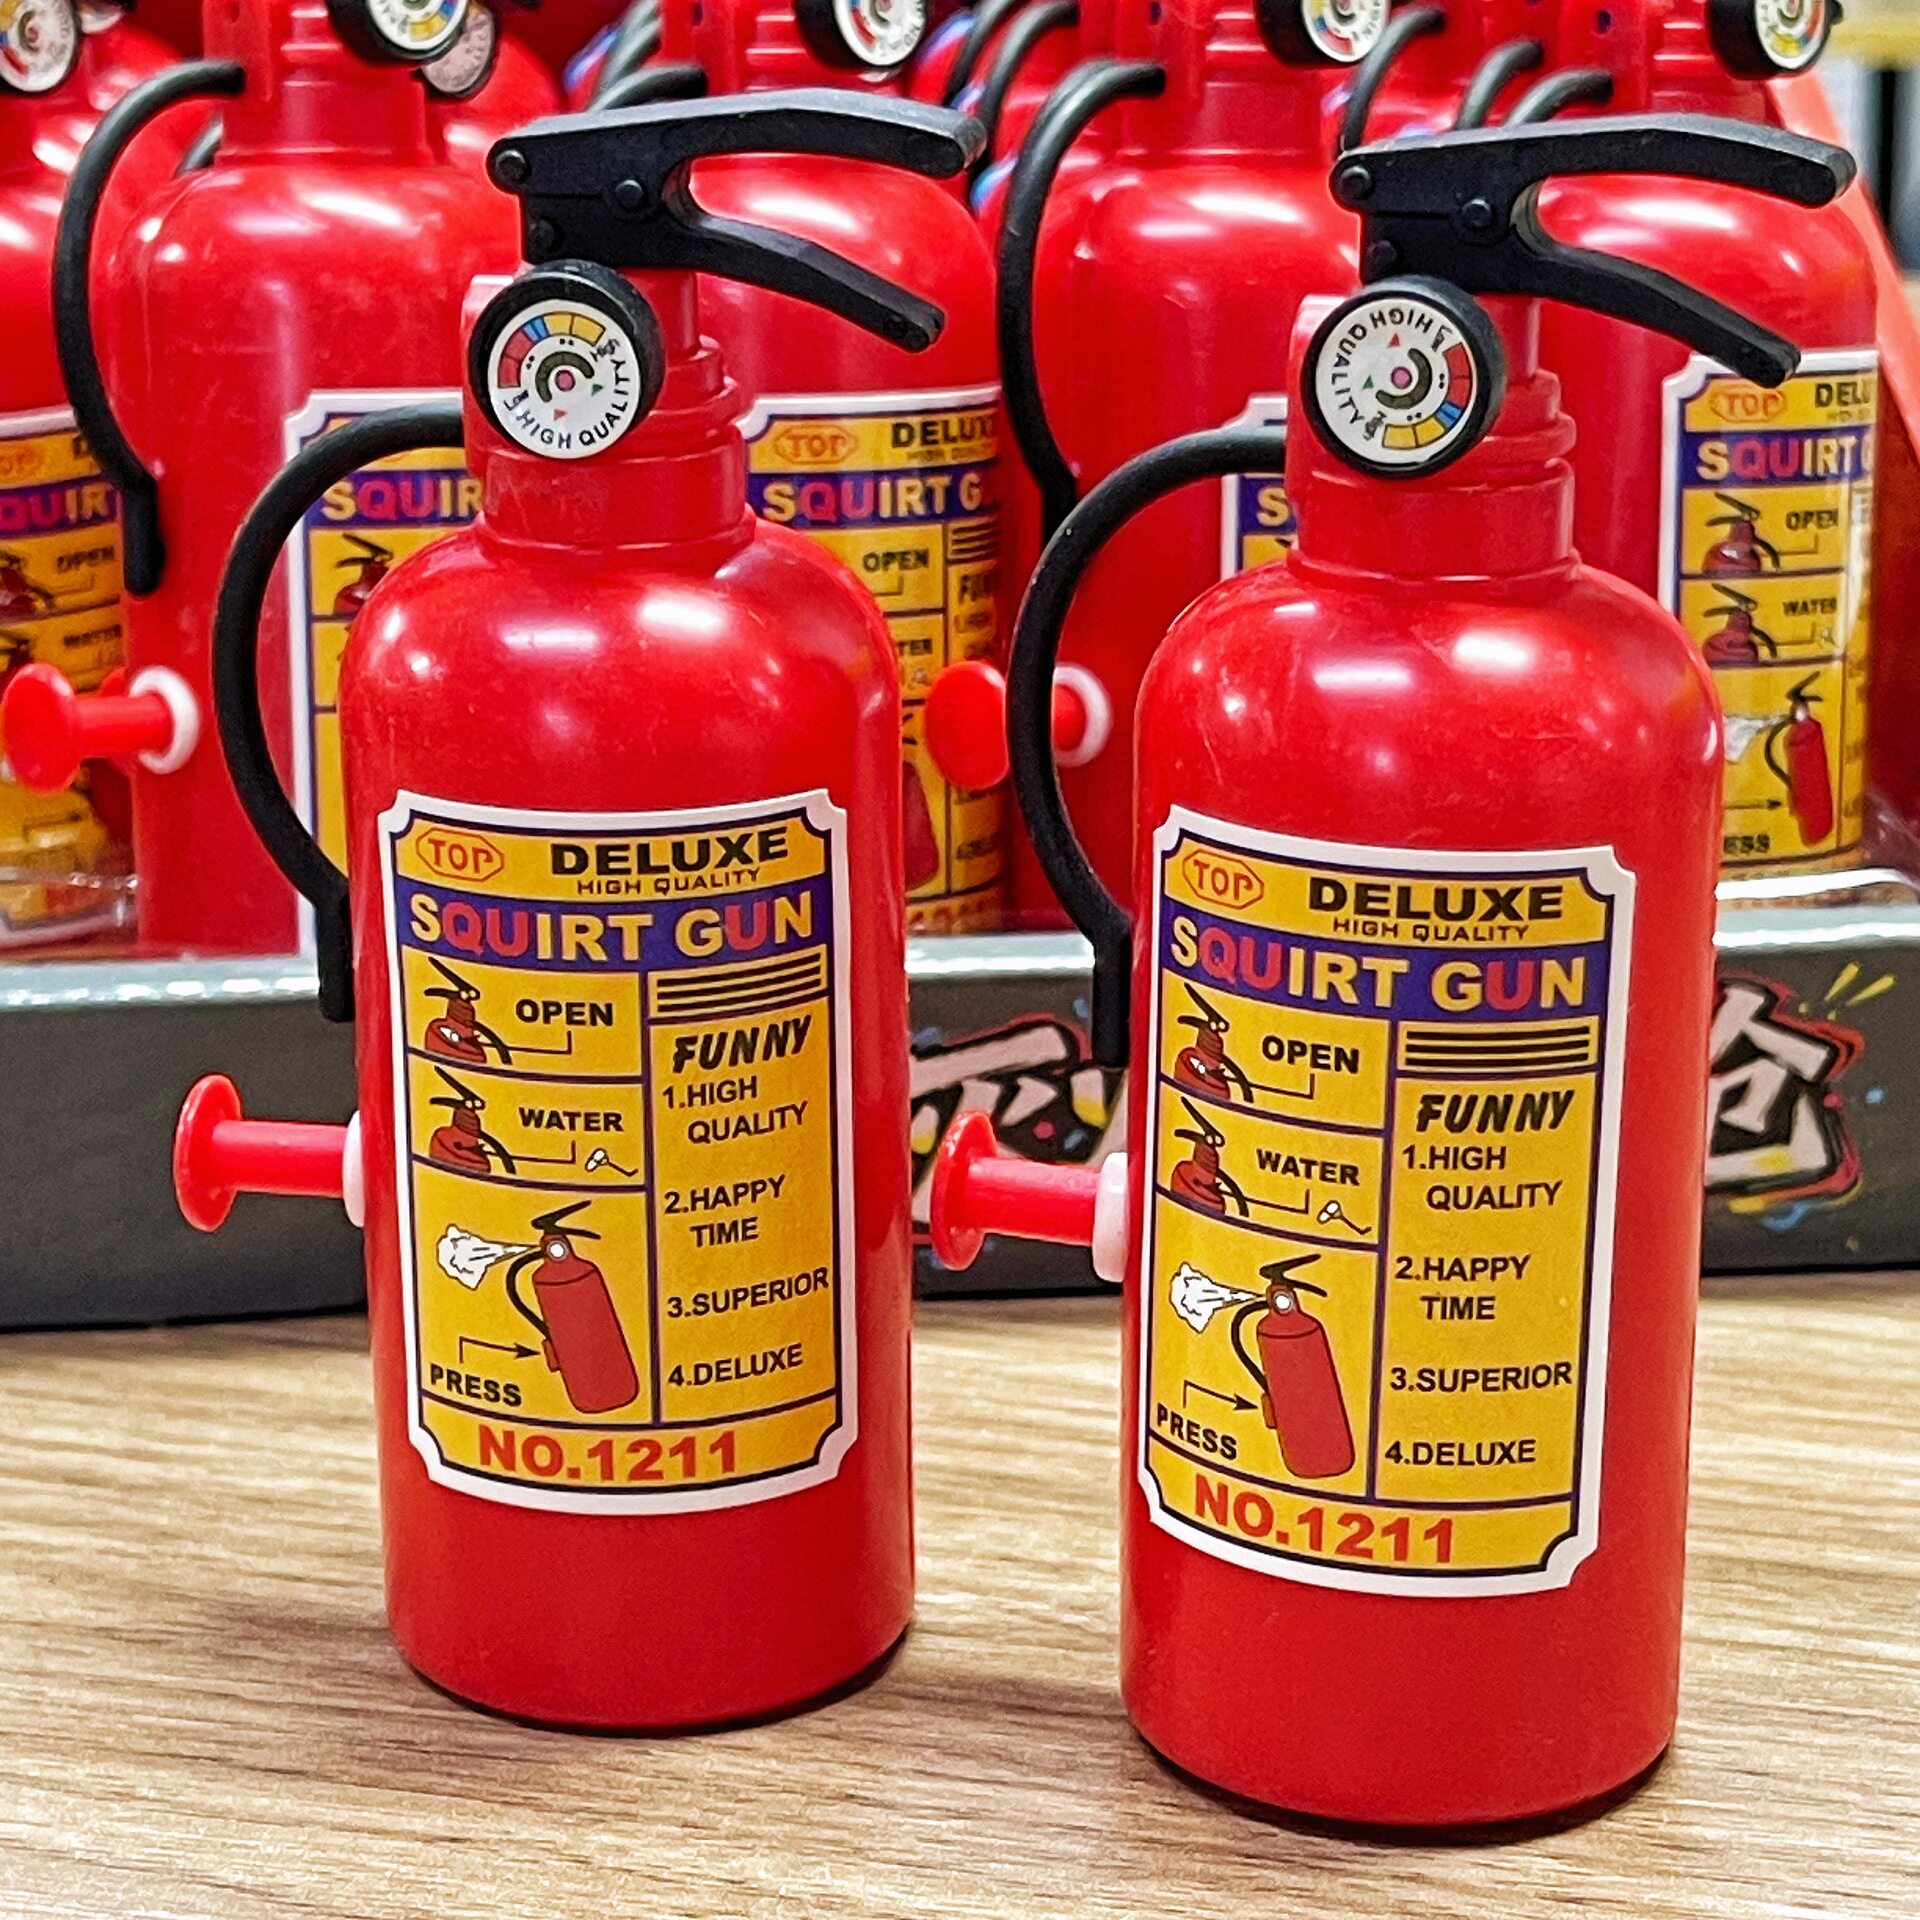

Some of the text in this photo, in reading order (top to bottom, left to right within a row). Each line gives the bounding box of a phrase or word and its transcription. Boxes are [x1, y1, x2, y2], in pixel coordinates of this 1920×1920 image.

[1370, 308, 1434, 333] HIGH
[1332, 322, 1367, 424] QUALITY
[516, 358, 631, 449] HIGH QUALITY
[1726, 393, 1780, 418] TOP
[1696, 434, 1858, 481] SQUIRT
[0, 483, 110, 530] QUIR
[320, 475, 484, 522] SQUIR
[762, 474, 953, 524] SQUIRT
[862, 548, 930, 573] OPEN
[897, 638, 933, 657] TER
[427, 837, 494, 876] TOP
[550, 825, 789, 876] DELUXE
[1723, 833, 1771, 854] ESS
[577, 867, 762, 896] HIGH QUALITY
[1193, 859, 1254, 901] TOP
[1308, 876, 1564, 923] DELUXE
[409, 889, 815, 963] SQUIRT GUN
[1333, 918, 1531, 943] HIGH QUALITY
[1170, 915, 1587, 1012] SQUIRT GUN
[515, 998, 614, 1027] OPEN
[672, 1014, 813, 1074] FUNNY
[1261, 1035, 1360, 1074] OPEN
[662, 1075, 758, 1110] 1.HIGH
[1416, 1089, 1575, 1134] FUNNY
[518, 1106, 625, 1132] WATER
[687, 1100, 809, 1144] QUALITY
[1255, 1148, 1360, 1187] WATER
[1401, 1144, 1507, 1171] 1.HIGH
[663, 1173, 786, 1215] 2.HAPPY
[1425, 1180, 1563, 1211] QUALITY
[689, 1216, 759, 1248] TIME
[1394, 1253, 1532, 1282] 2.HAPPY
[666, 1265, 830, 1319] 3.SUPERIOR
[1419, 1294, 1496, 1320] TIME
[430, 1362, 523, 1407] PRESS
[668, 1342, 804, 1387] 4.DELUXE
[1389, 1360, 1573, 1393] 3.SUPERIOR
[477, 1424, 738, 1481] NO.1211
[1156, 1403, 1238, 1461] PRESS
[1384, 1438, 1537, 1467] 4.DELUXE
[1194, 1472, 1454, 1564] NO.1211
